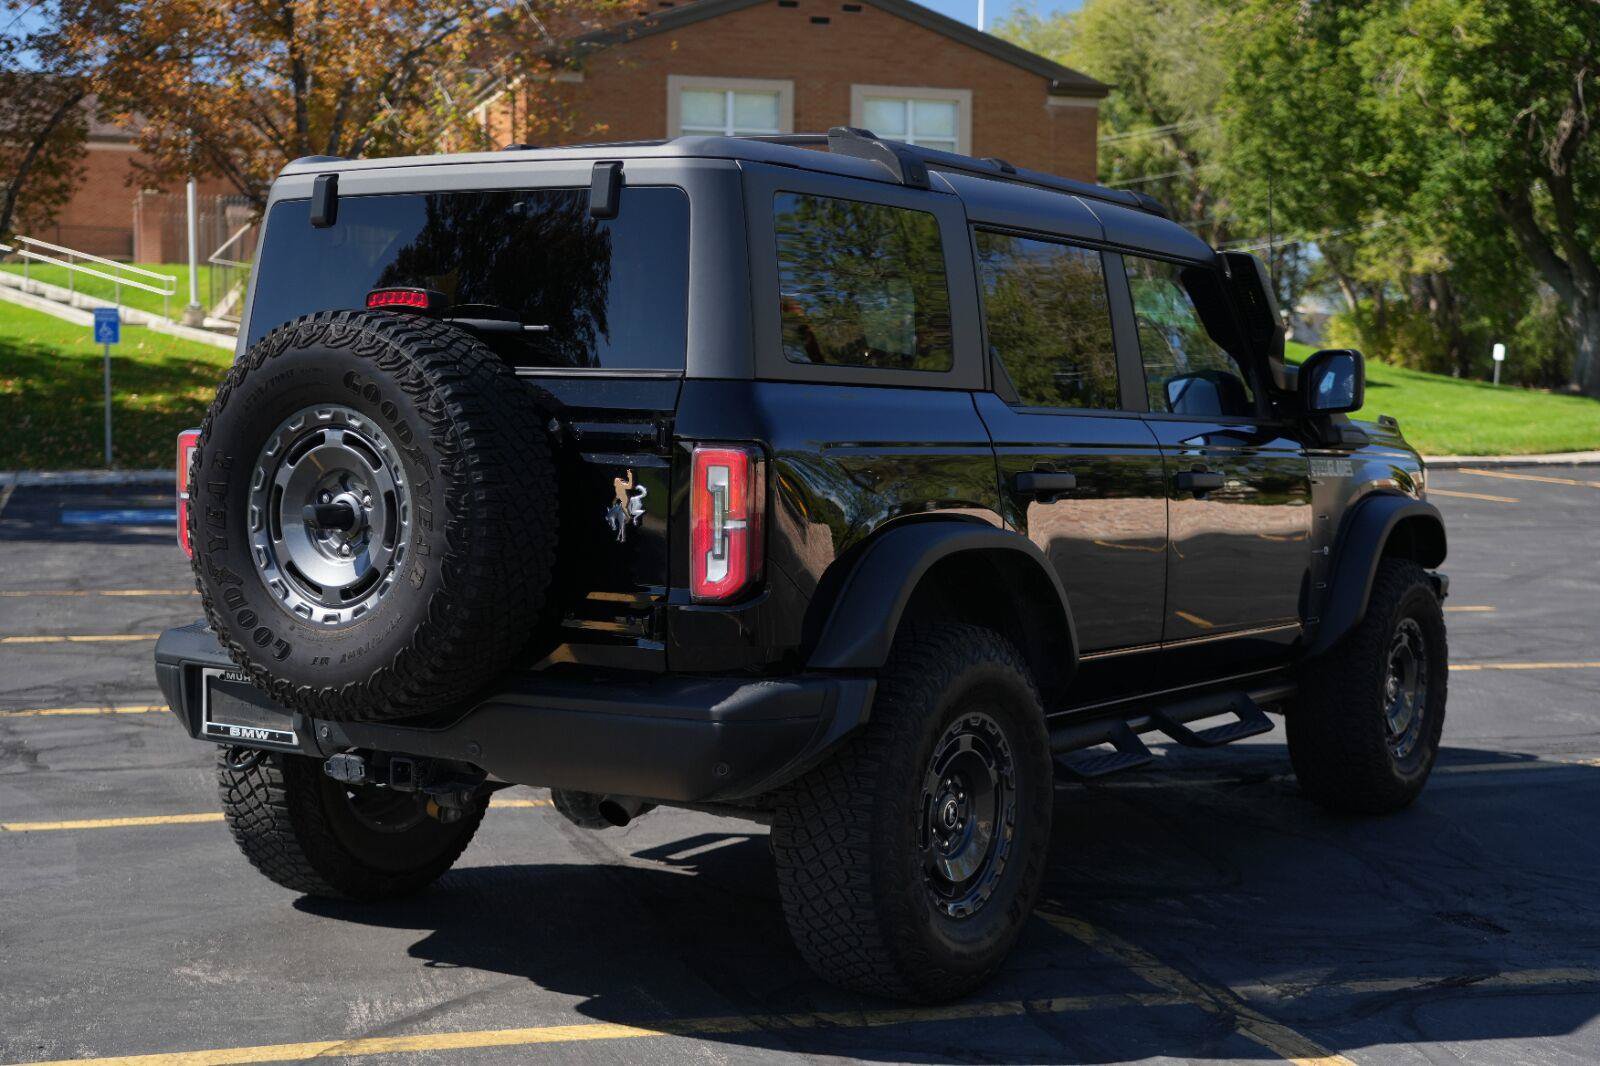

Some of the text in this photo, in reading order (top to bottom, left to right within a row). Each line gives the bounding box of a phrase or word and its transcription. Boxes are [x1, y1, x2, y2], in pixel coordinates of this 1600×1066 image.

[204, 451, 292, 661] GOODYEAR
[343, 369, 434, 590] GOODYEAR
[229, 726, 269, 740] BMW
